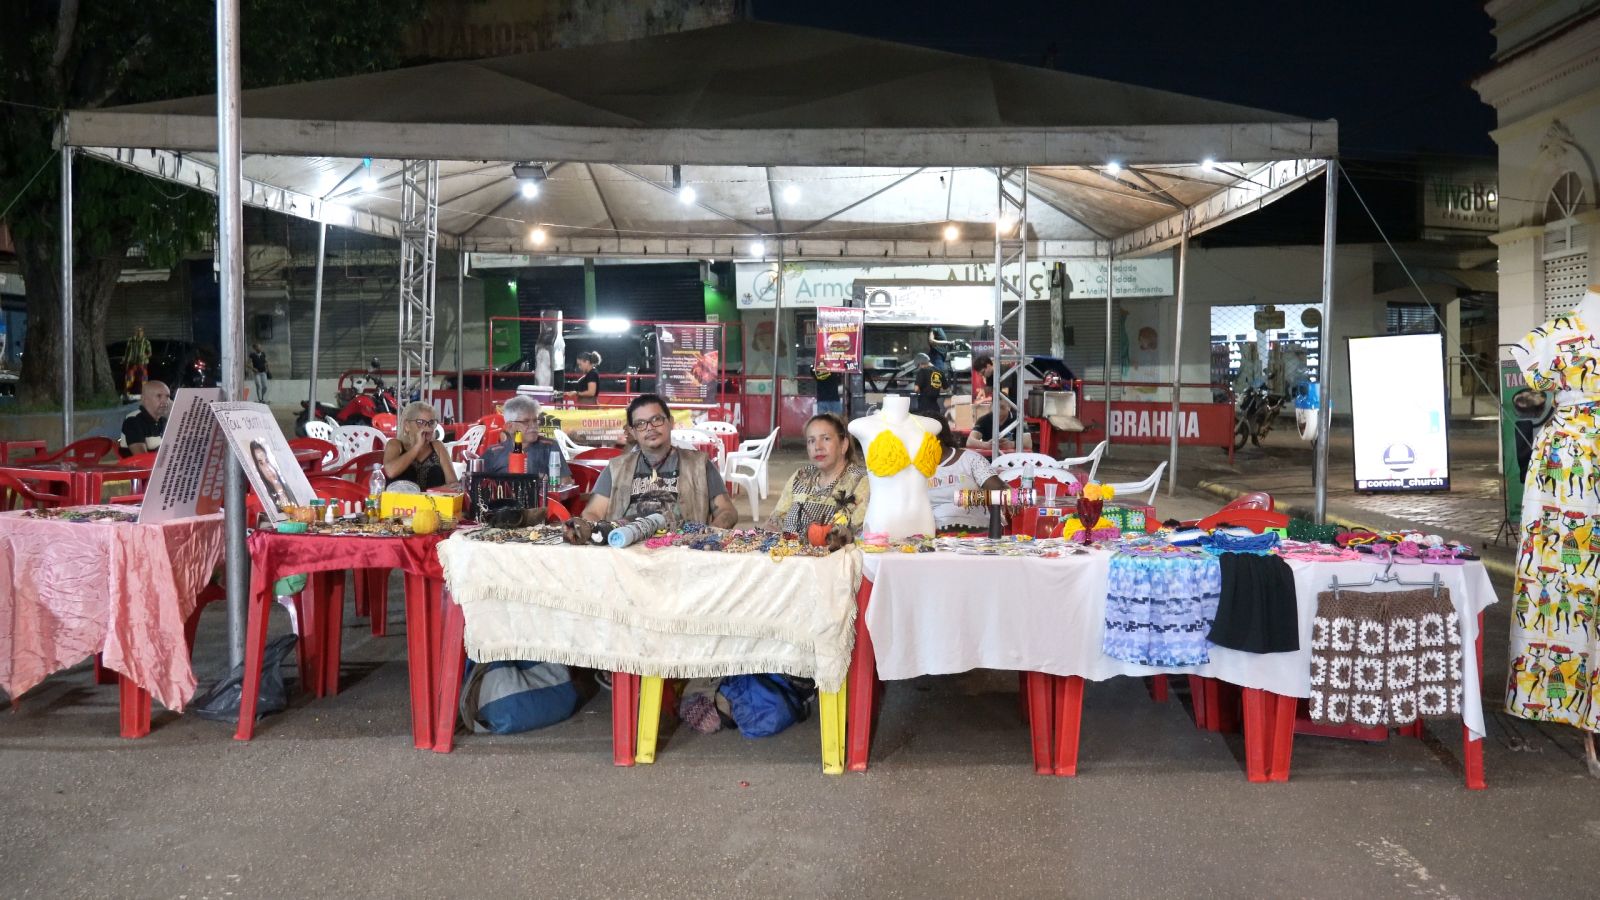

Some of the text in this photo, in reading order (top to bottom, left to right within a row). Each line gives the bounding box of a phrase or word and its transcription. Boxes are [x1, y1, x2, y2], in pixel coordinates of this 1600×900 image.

[1099, 264, 1137, 272] Vaedade
[1096, 275, 1137, 284] Qulidade
[1110, 410, 1200, 438] BRAHMA
